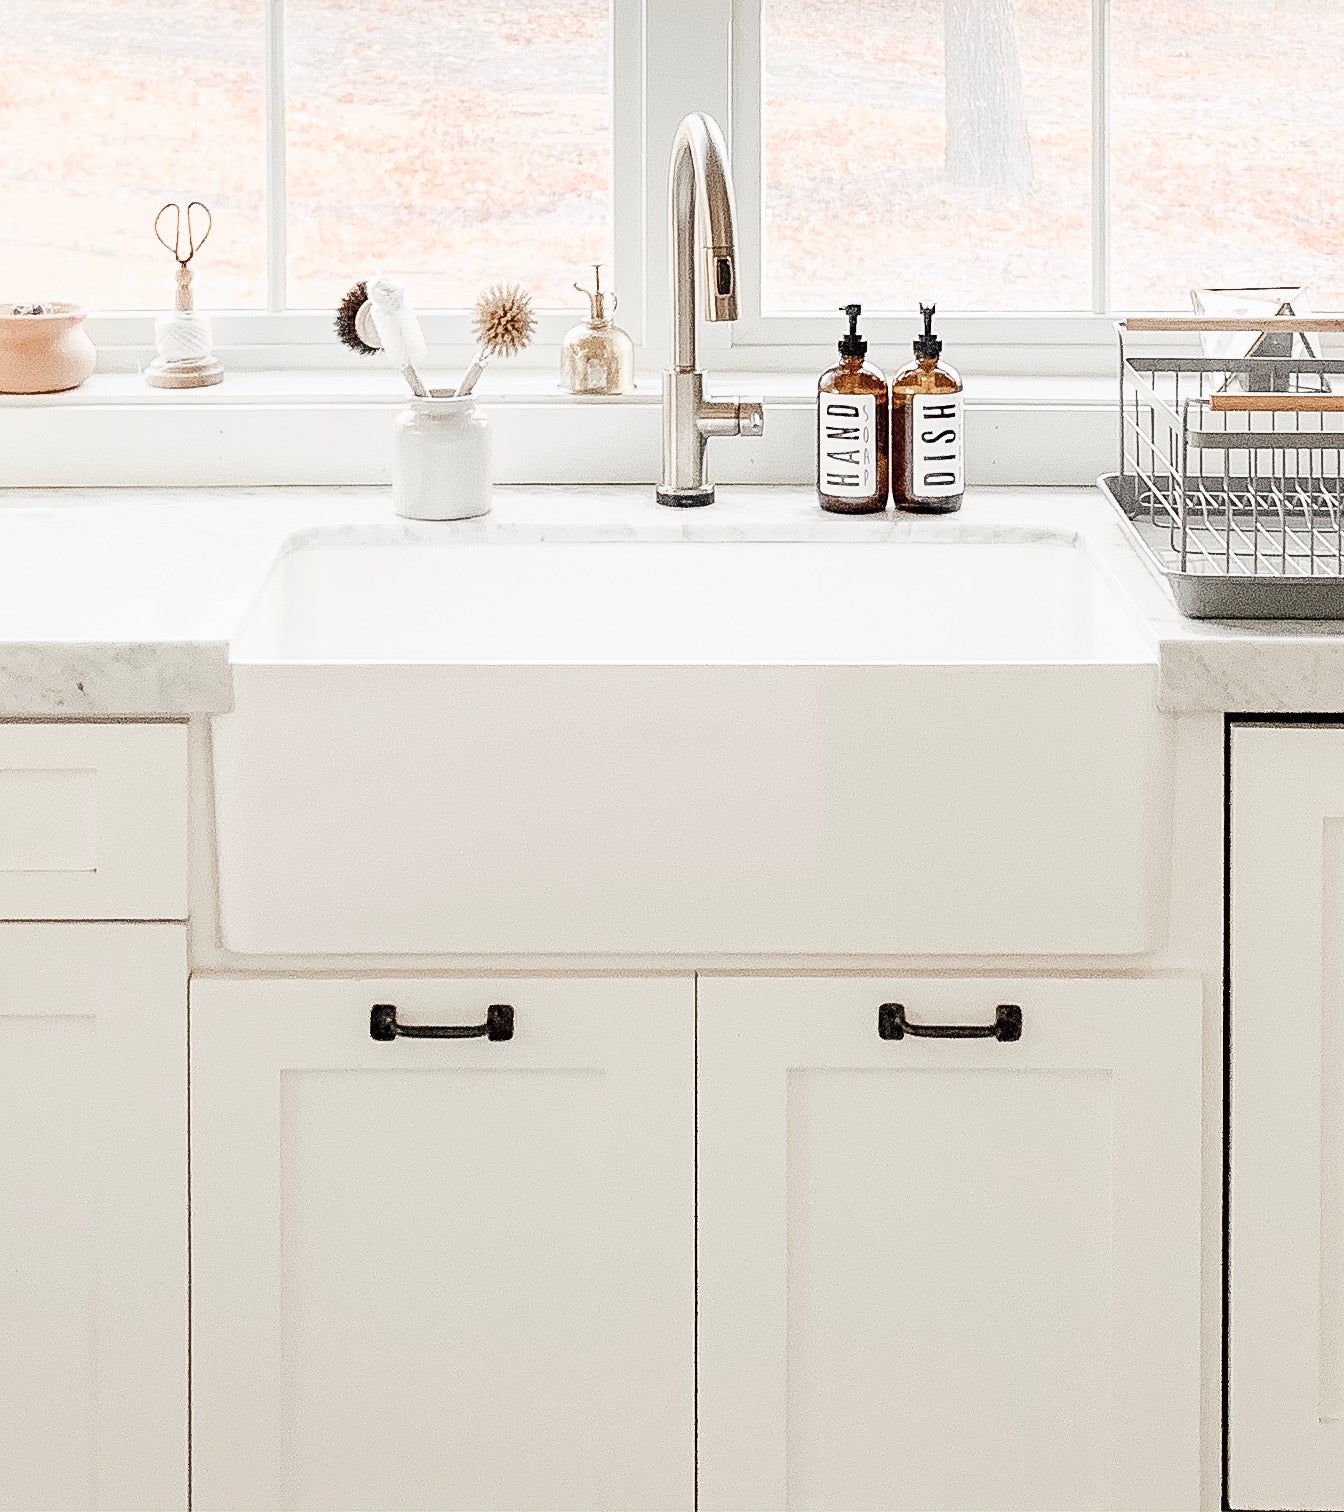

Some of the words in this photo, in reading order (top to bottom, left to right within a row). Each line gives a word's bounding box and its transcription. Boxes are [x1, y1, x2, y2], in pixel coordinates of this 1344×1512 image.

[825, 404, 860, 486] HAND
[862, 404, 870, 486] SOAP
[921, 404, 956, 486] DISH
